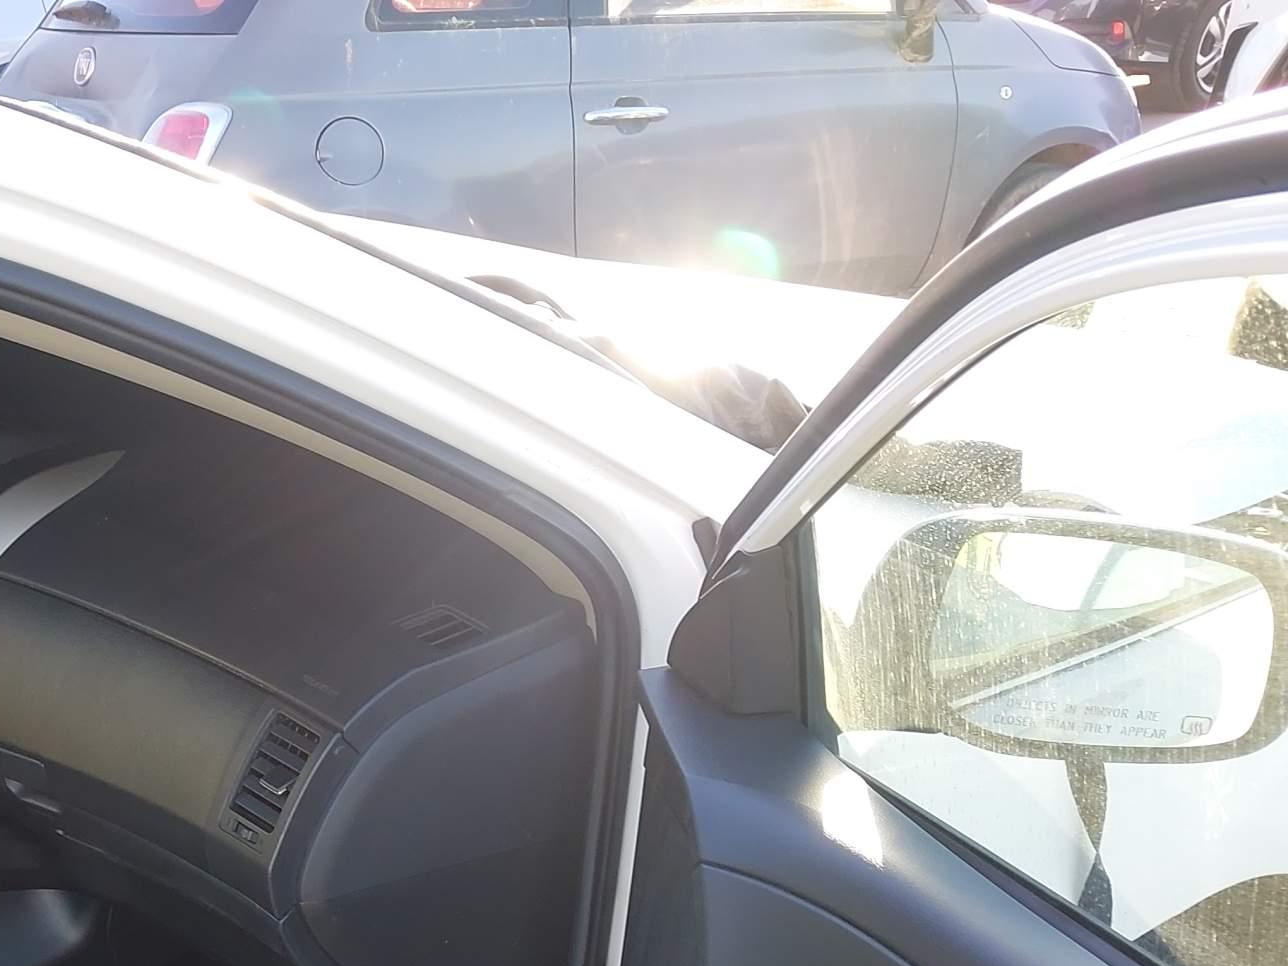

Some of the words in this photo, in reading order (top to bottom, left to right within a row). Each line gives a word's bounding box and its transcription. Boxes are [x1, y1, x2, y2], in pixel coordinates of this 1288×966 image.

[1136, 709, 1161, 722] ARE
[1083, 721, 1113, 734] THEY
[1120, 725, 1168, 740] APPEAR
